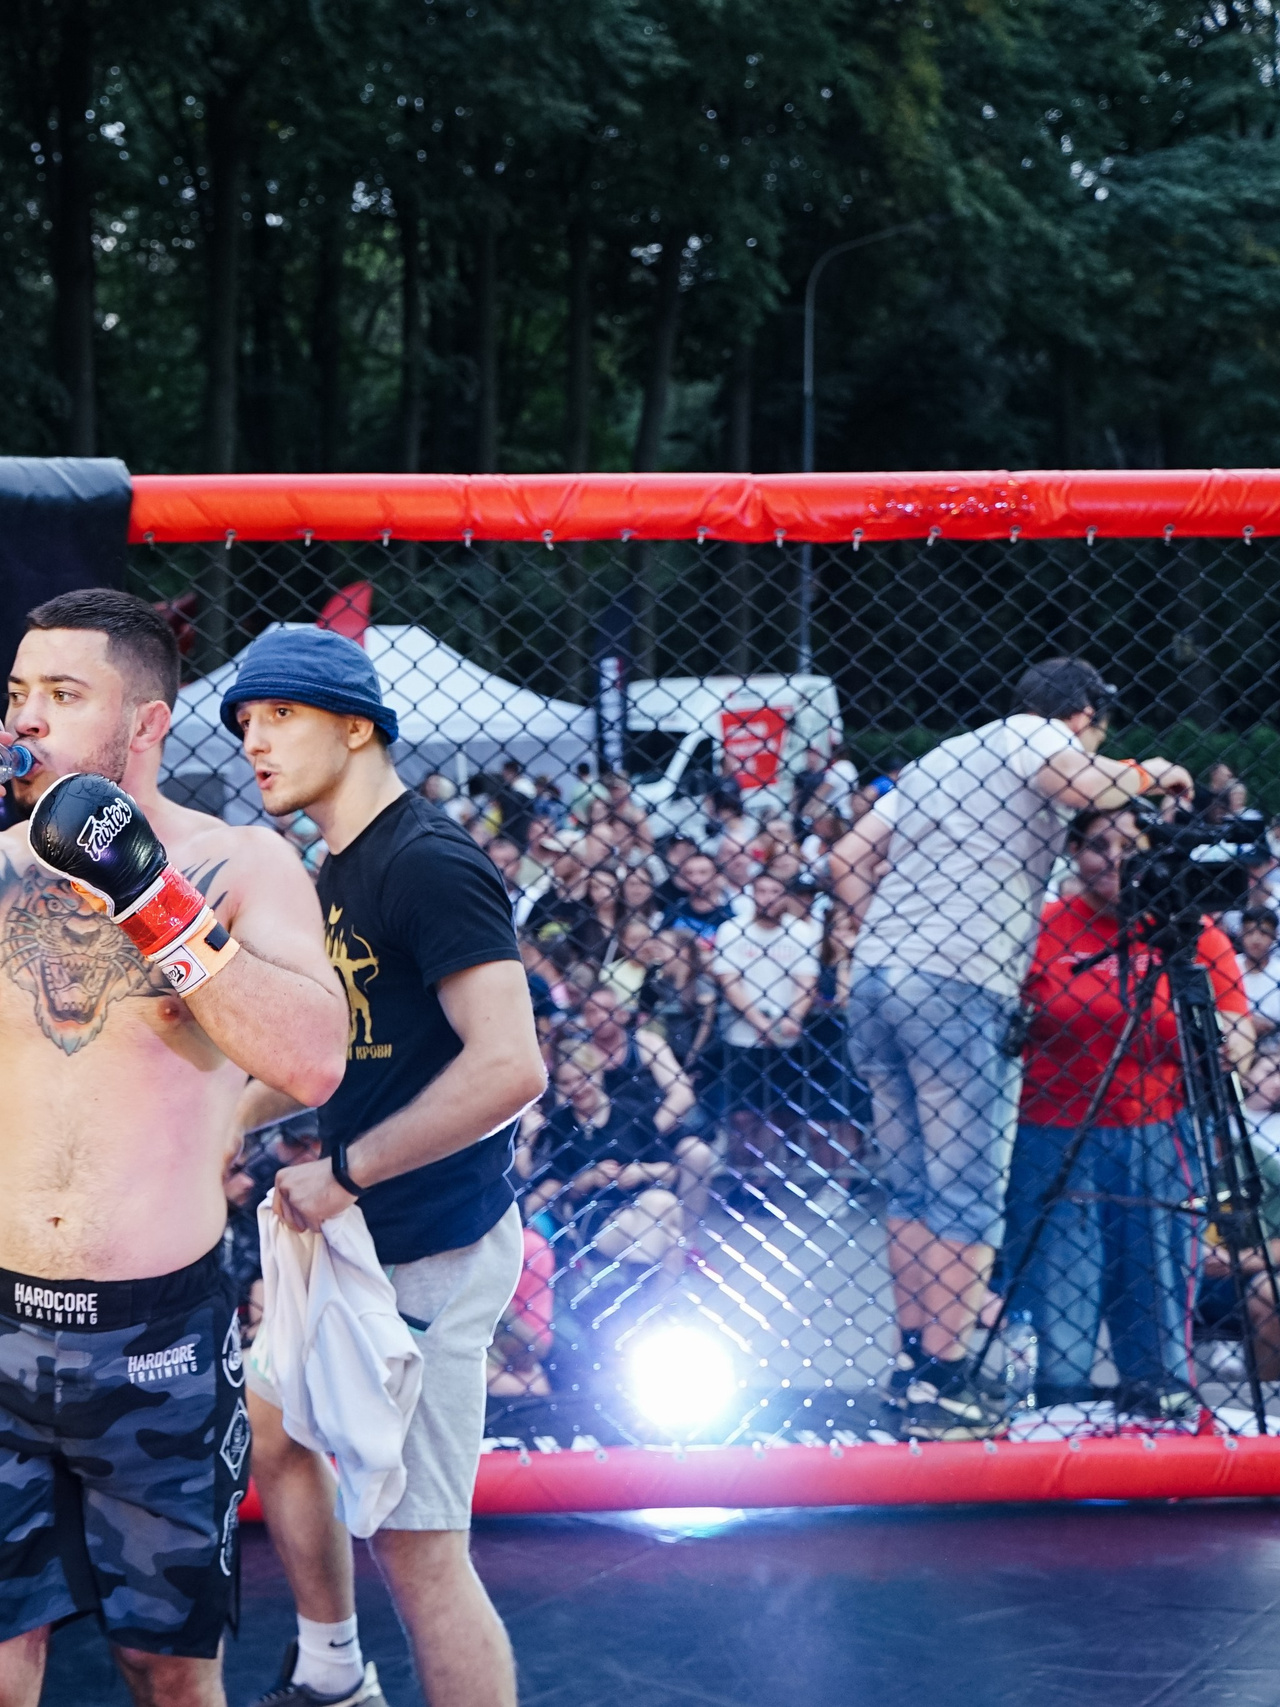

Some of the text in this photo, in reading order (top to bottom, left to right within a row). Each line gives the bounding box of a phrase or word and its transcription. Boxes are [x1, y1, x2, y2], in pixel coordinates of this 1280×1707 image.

[76, 797, 132, 862] Fairtex
[355, 1044, 392, 1060] КРОВИ
[14, 1282, 98, 1312] HARDCORE
[15, 1302, 98, 1325] TRAINING
[127, 1343, 197, 1373] HARDCORE
[128, 1361, 198, 1384] TRAINING
